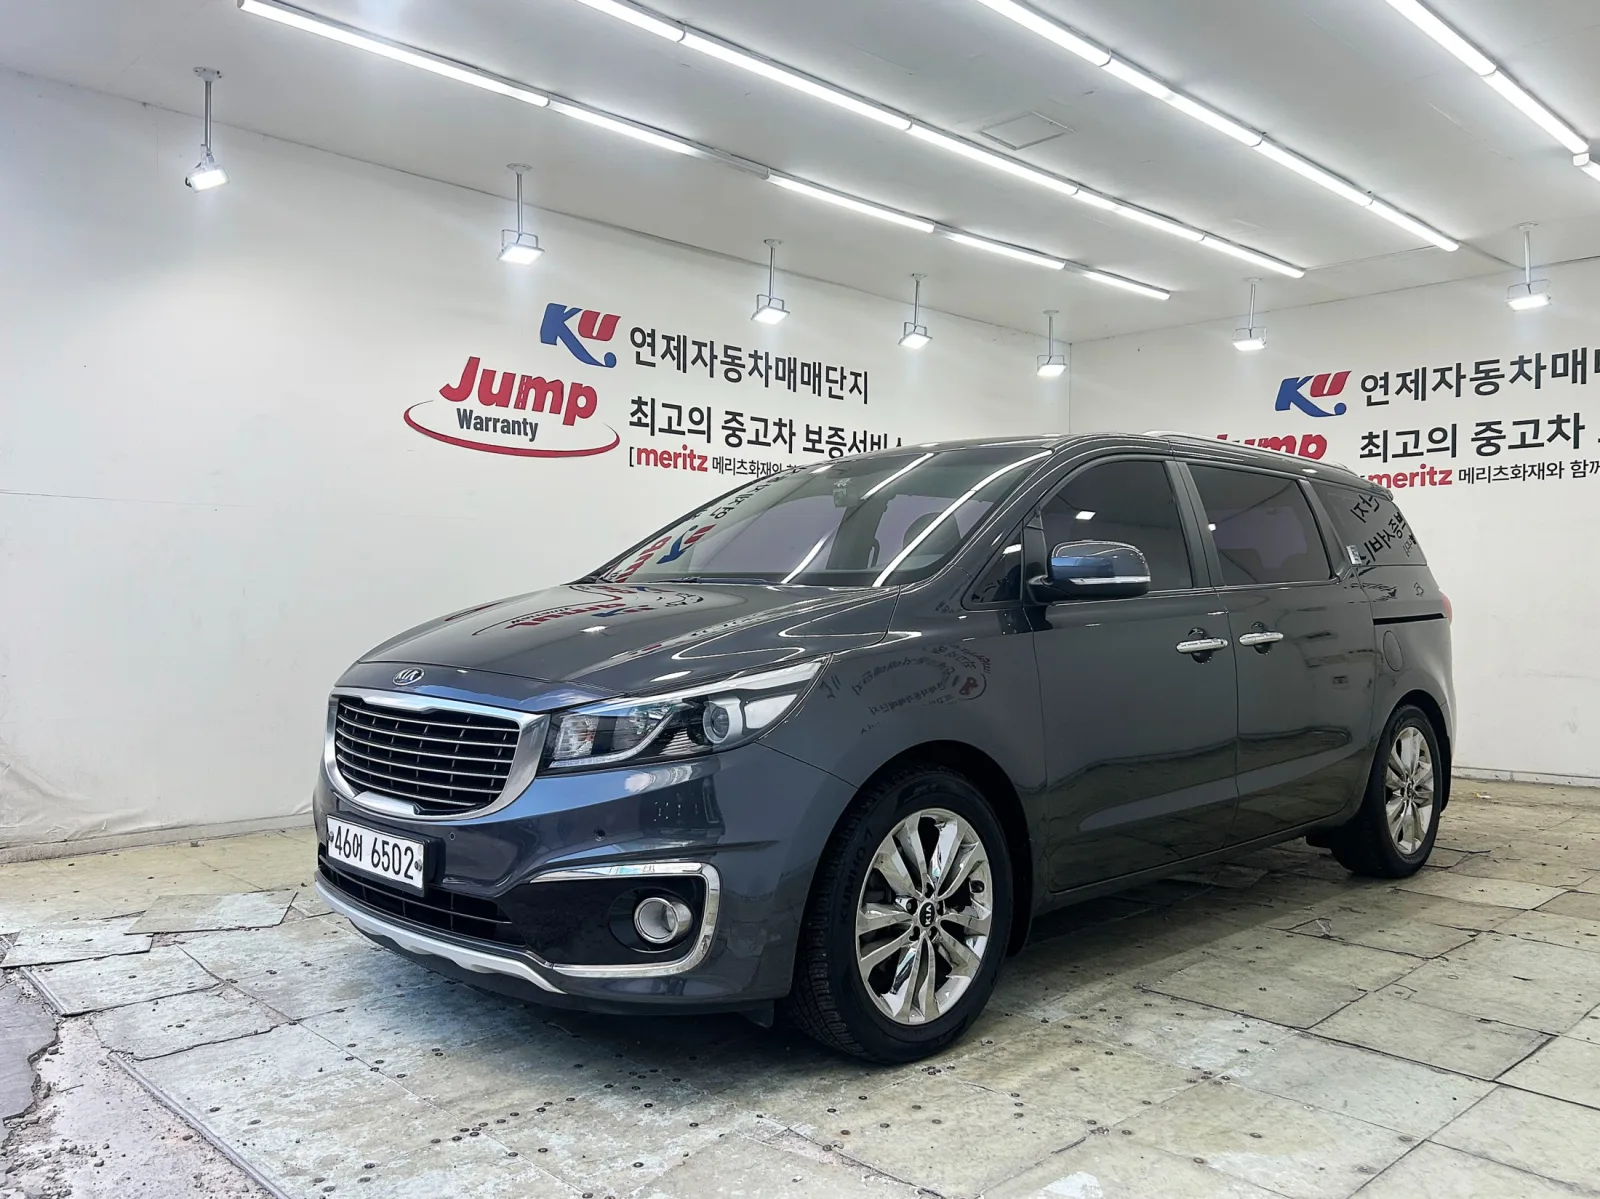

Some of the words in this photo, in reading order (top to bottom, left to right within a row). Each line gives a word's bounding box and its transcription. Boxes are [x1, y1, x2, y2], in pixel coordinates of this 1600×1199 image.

[439, 356, 598, 426] Jump
[629, 326, 868, 405] 연제자동차매매단지
[456, 407, 539, 443] Warranty
[629, 395, 712, 444] 최고의
[721, 410, 797, 455] 중고차
[1359, 423, 1457, 464] 최고의
[1470, 412, 1586, 457] 중고차
[1458, 460, 1565, 485] 메리츠화재와
[371, 836, 414, 880] 6502
